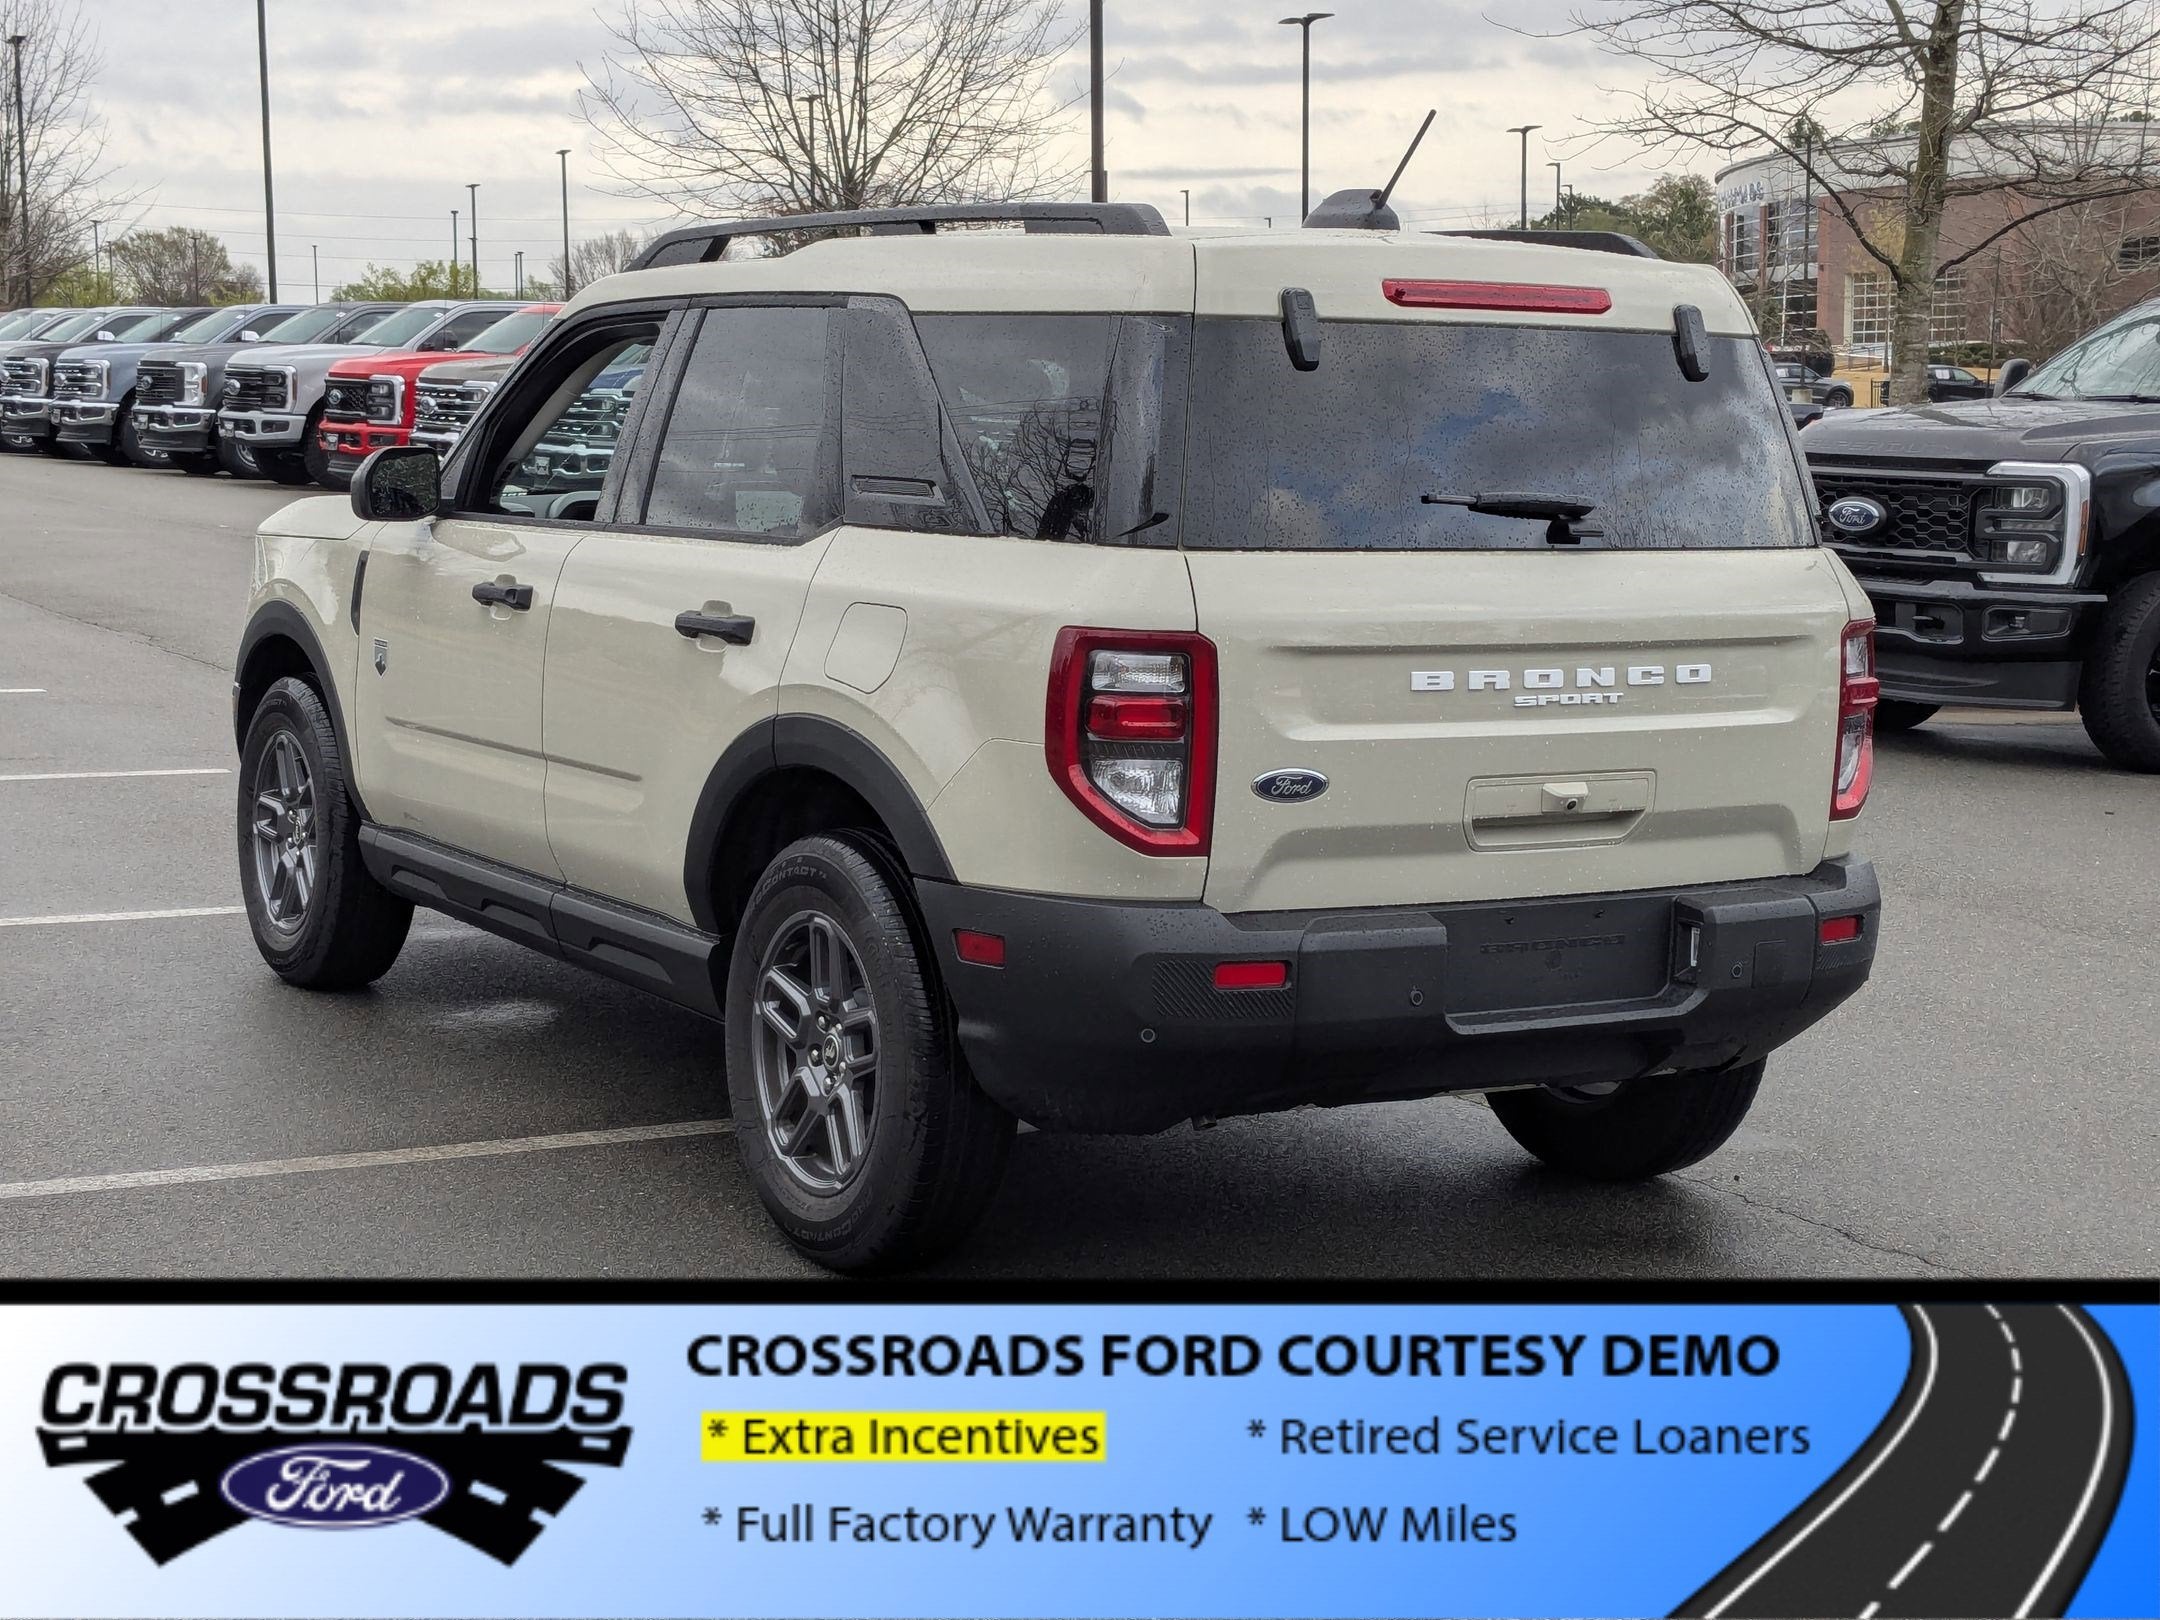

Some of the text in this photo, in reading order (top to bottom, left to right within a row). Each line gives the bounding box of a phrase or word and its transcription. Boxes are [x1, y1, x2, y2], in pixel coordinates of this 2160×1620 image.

[1838, 506, 1867, 526] Ford
[1410, 663, 1712, 691] BRONCO
[1513, 692, 1624, 708] SPORT
[1270, 775, 1313, 796] Ford
